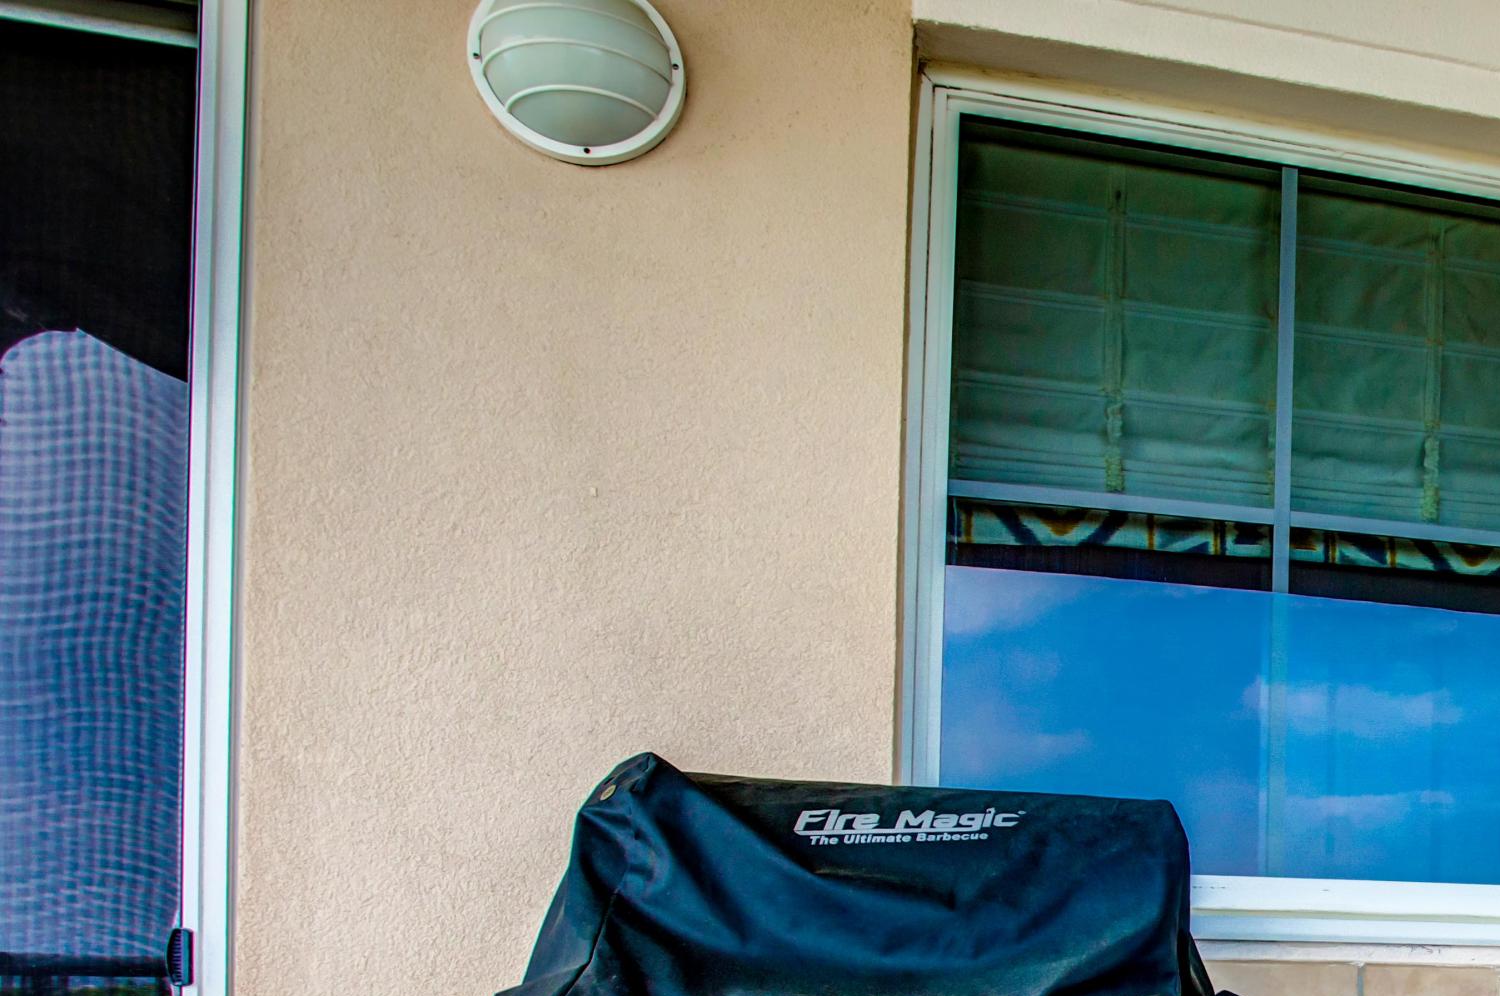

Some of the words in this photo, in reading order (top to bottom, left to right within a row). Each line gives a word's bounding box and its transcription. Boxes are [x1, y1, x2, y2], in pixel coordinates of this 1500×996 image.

[793, 809, 880, 833] Fire
[895, 807, 1022, 832] Magic
[810, 834, 838, 845] The
[843, 832, 912, 844] Ultimate
[916, 831, 989, 842] Barbecue
